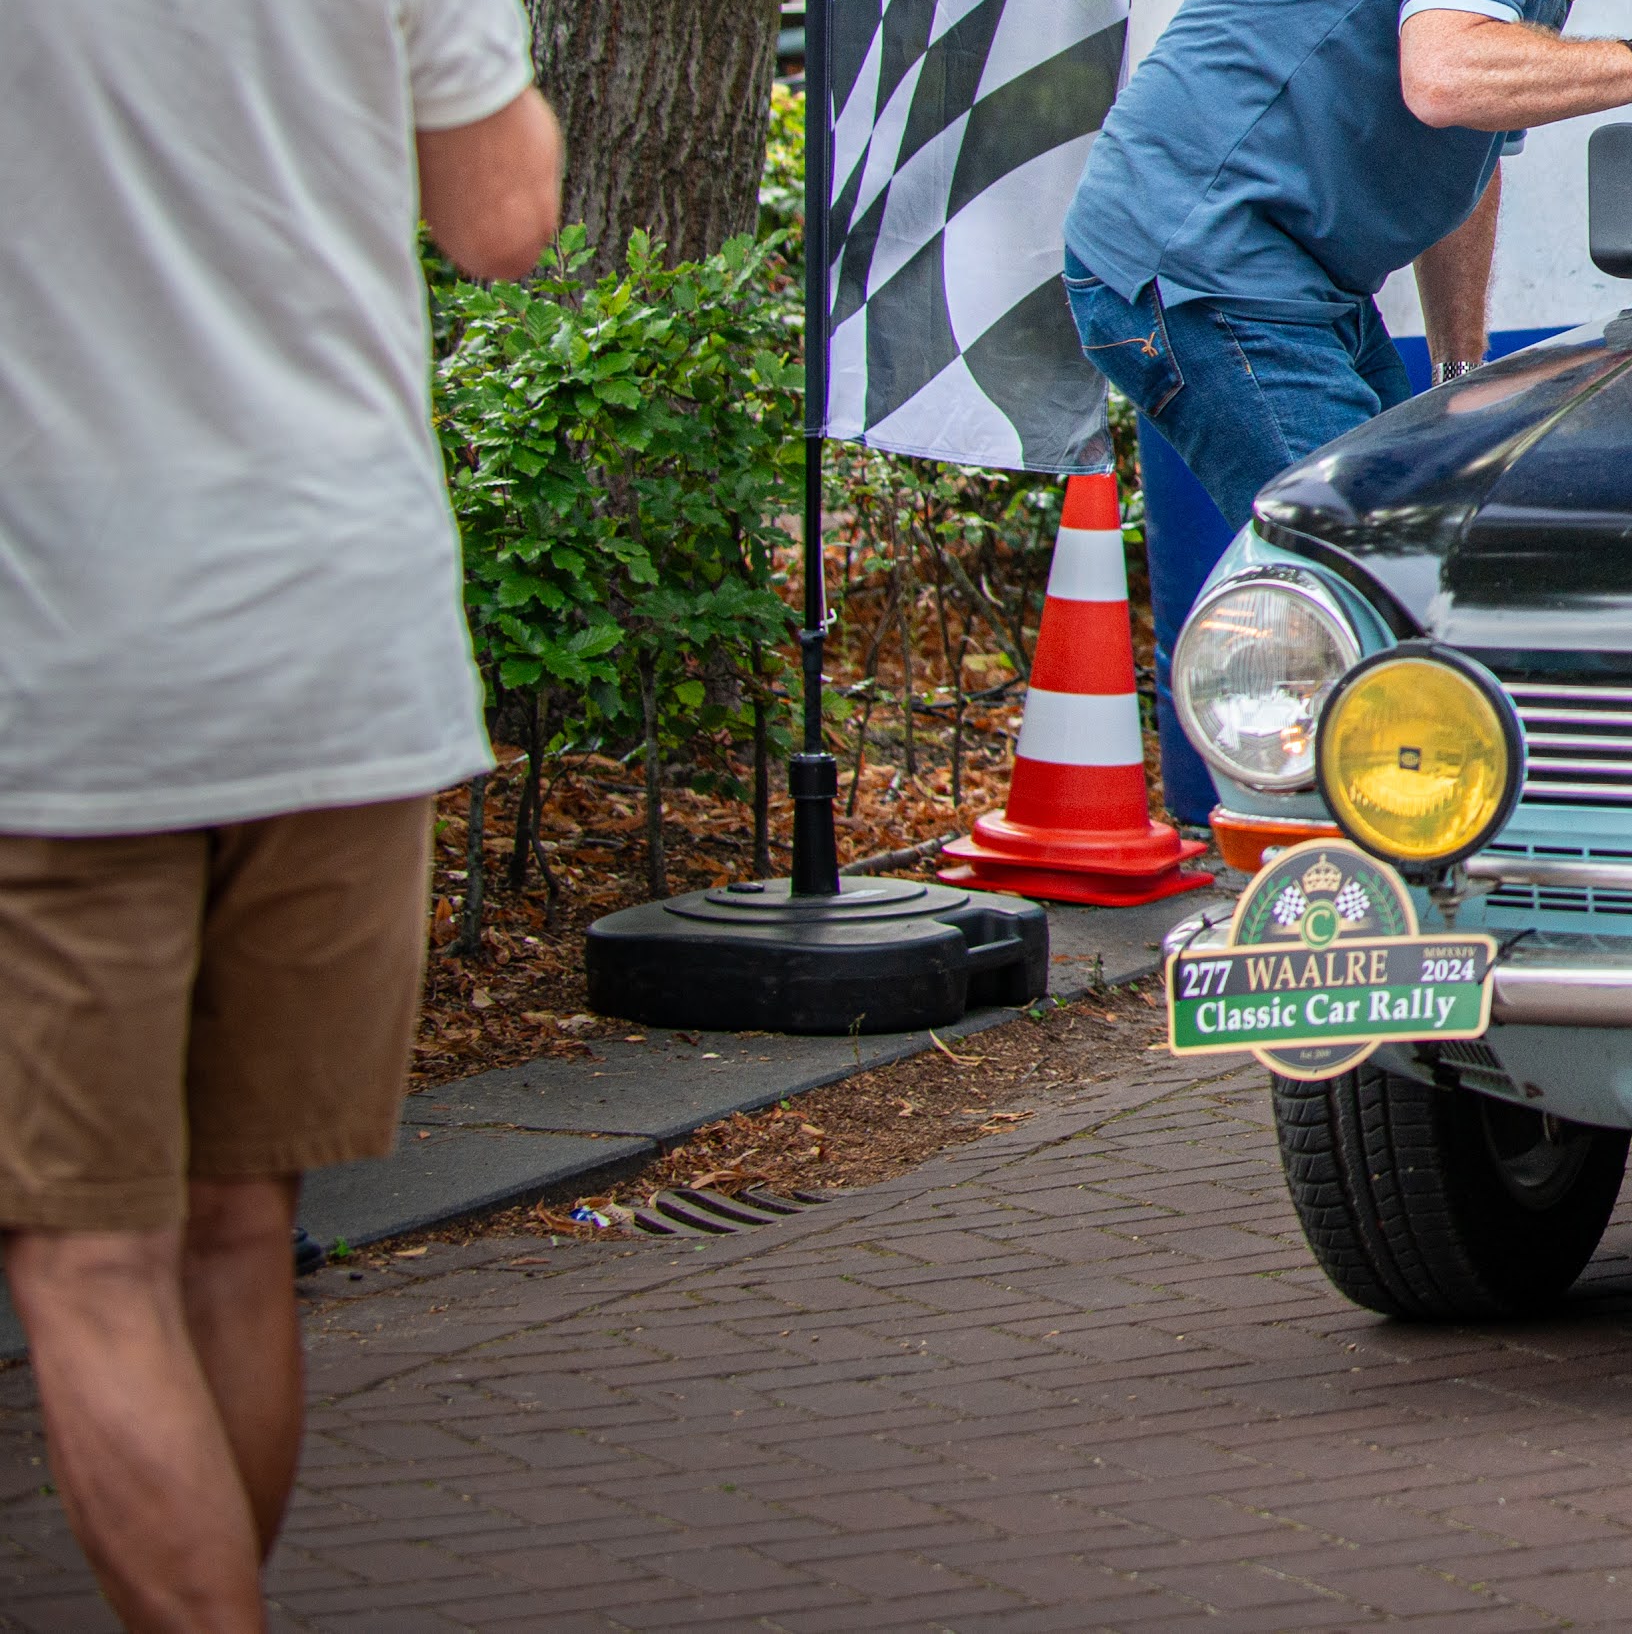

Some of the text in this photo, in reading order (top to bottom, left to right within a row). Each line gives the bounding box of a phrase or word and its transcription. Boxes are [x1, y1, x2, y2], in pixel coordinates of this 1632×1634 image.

[1182, 950, 1475, 997] 277 WAALRE 2024
[1196, 987, 1456, 1034] Classic Car Rally
